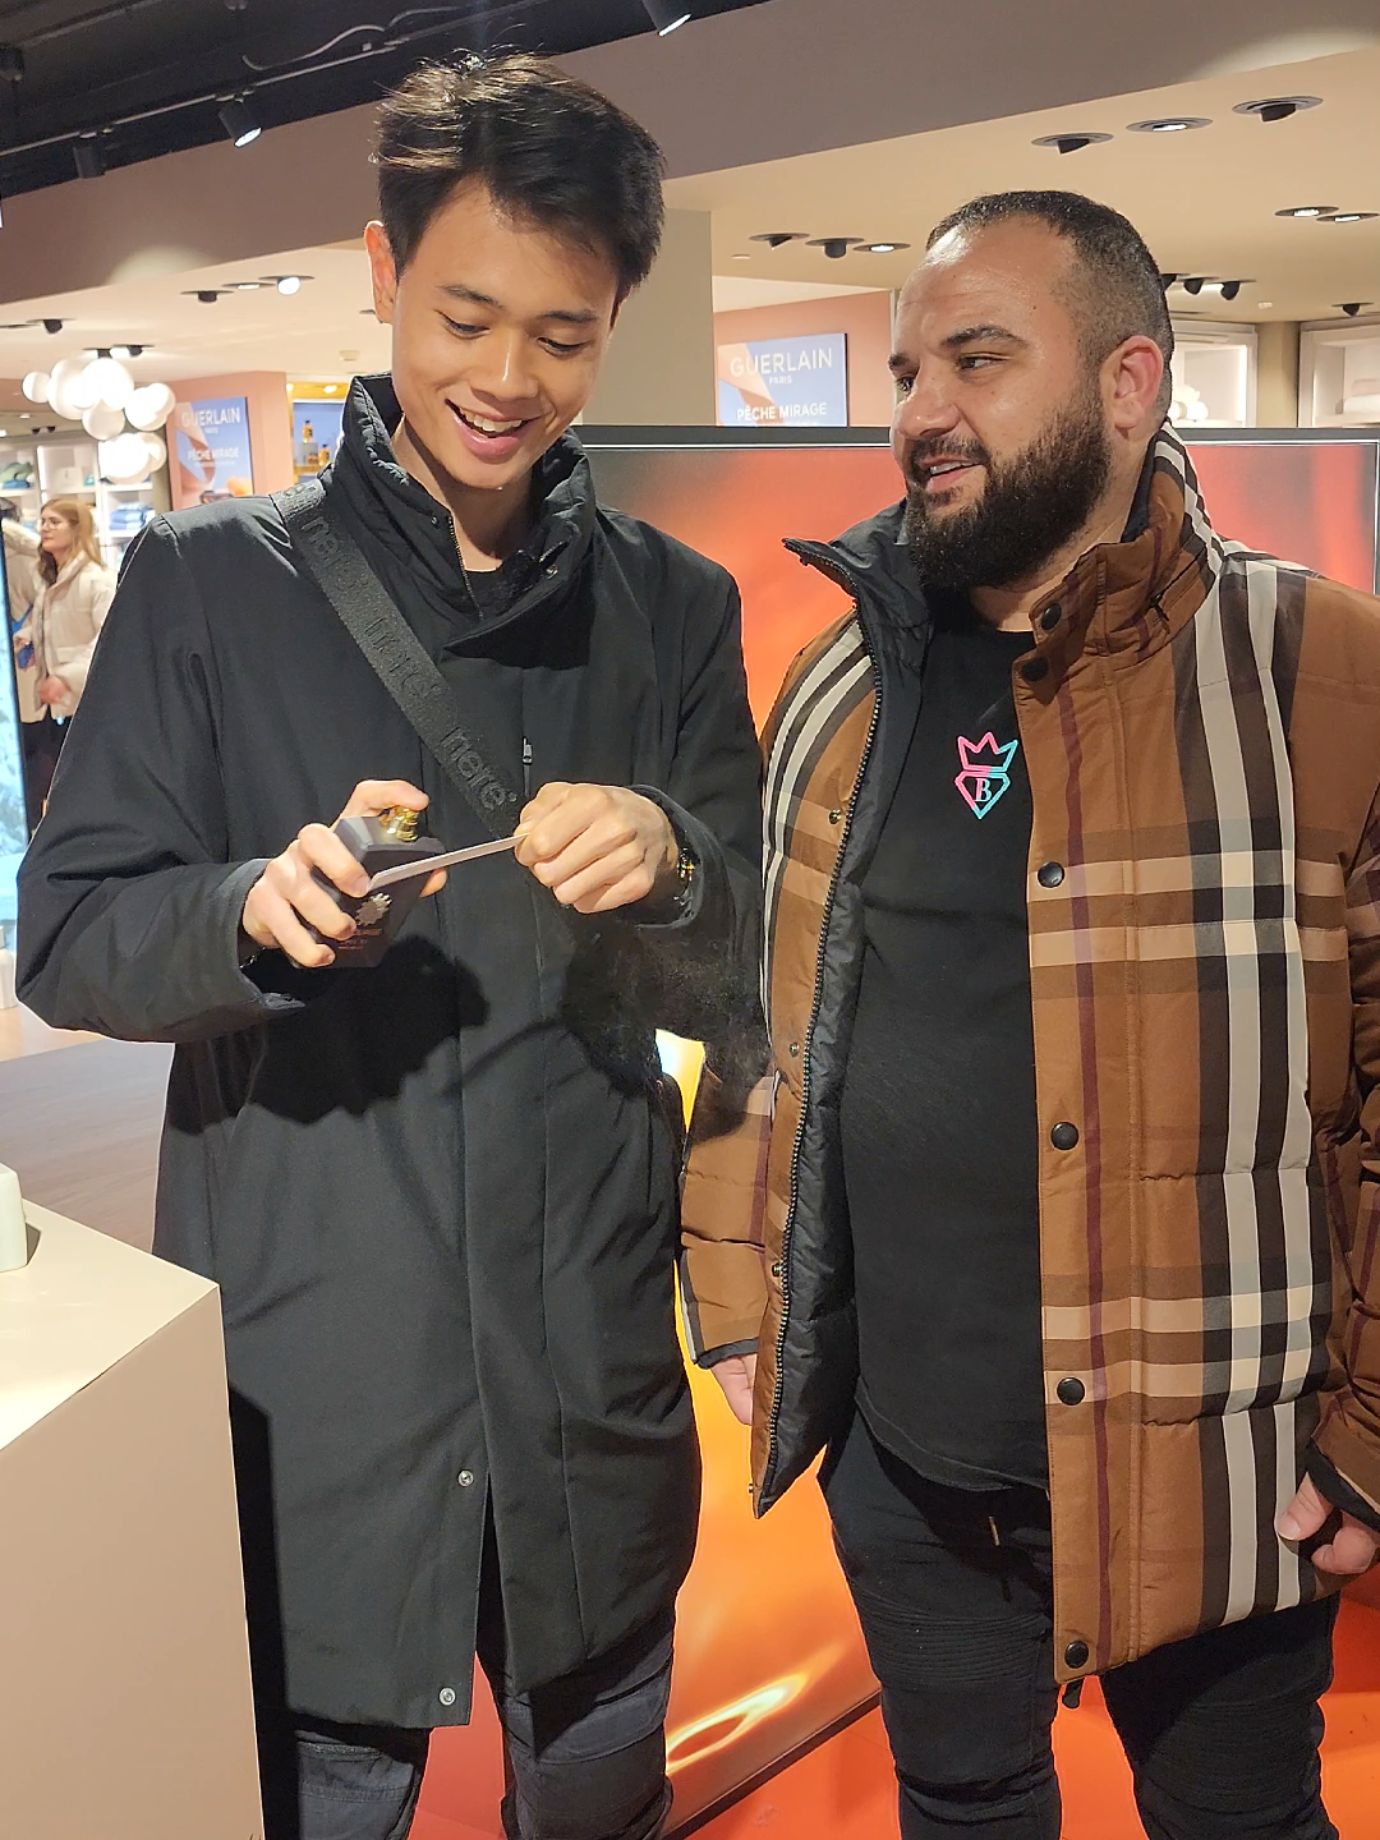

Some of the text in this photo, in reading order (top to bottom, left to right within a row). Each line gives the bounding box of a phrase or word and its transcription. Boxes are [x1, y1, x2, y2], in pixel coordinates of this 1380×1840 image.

[731, 347, 832, 377] GUERLAIN
[769, 375, 793, 385] PARIS
[182, 407, 240, 427] GUERLAIN
[779, 402, 827, 418] MIRAGE
